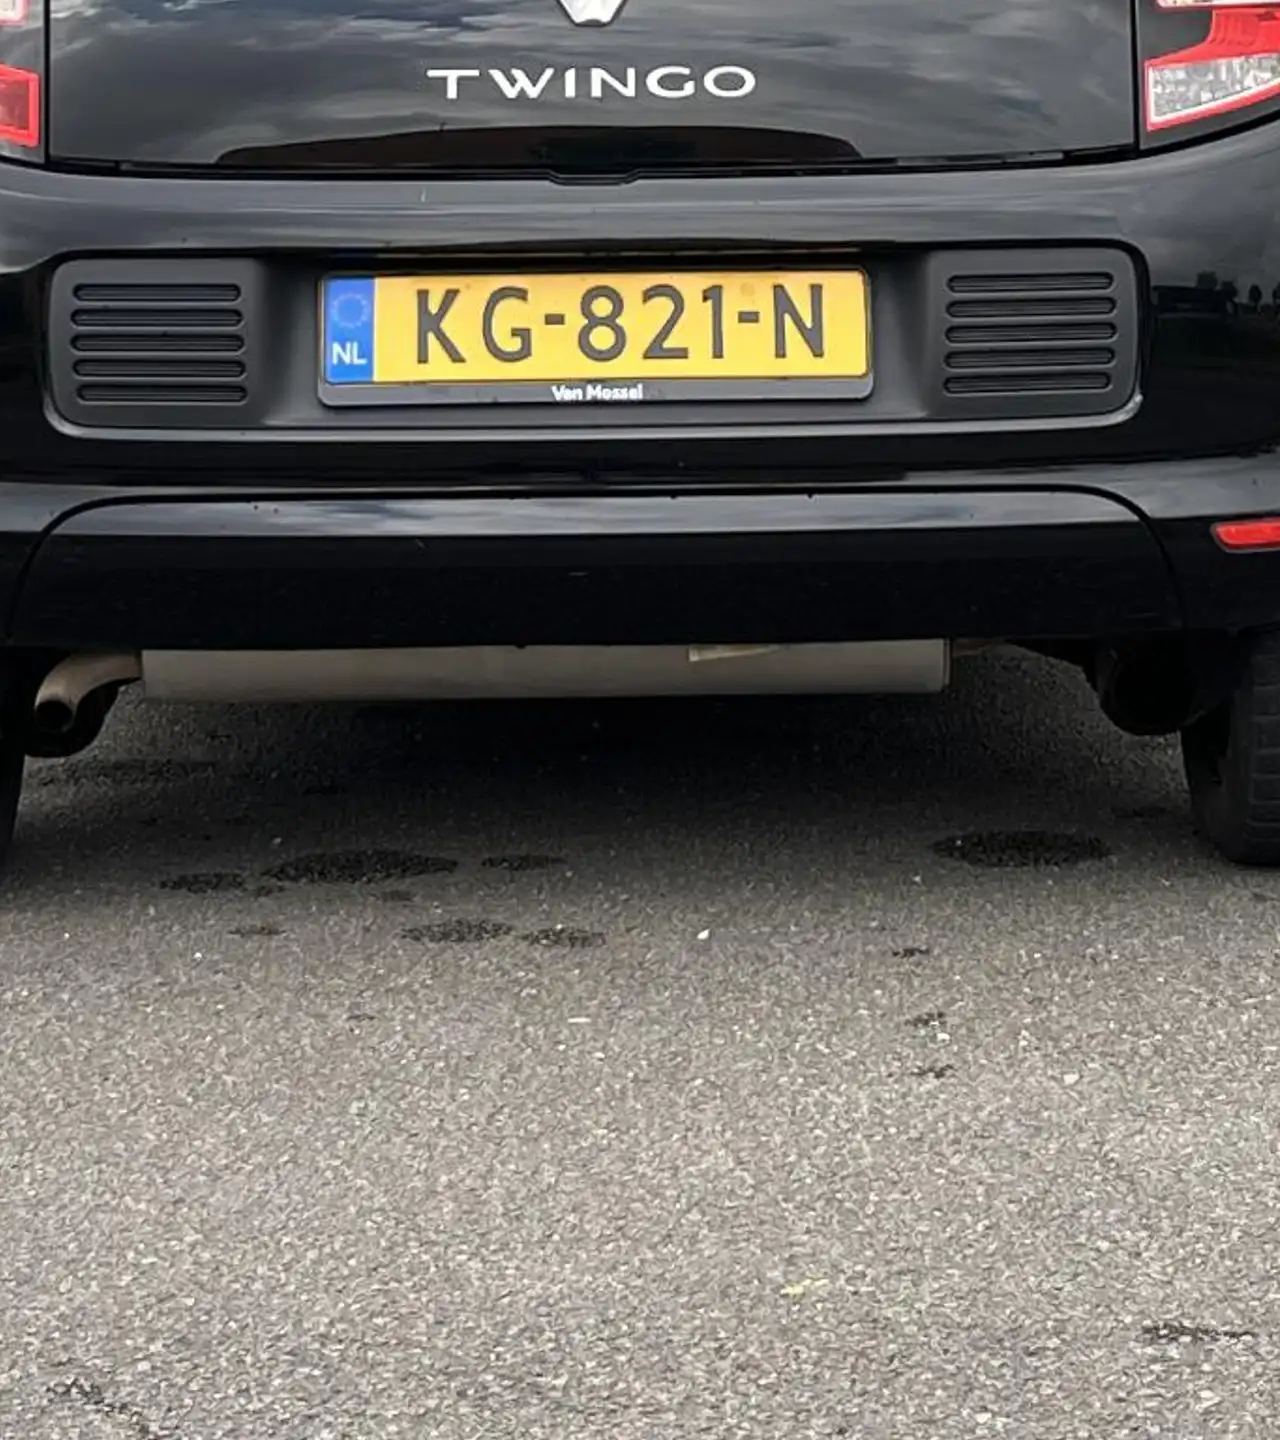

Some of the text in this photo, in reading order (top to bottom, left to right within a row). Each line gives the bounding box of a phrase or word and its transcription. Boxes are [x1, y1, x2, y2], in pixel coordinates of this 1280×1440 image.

[426, 65, 756, 99] TWINGO
[415, 283, 825, 364] KG-821-N
[331, 343, 368, 366] NL
[551, 383, 643, 401] Van Mossel
